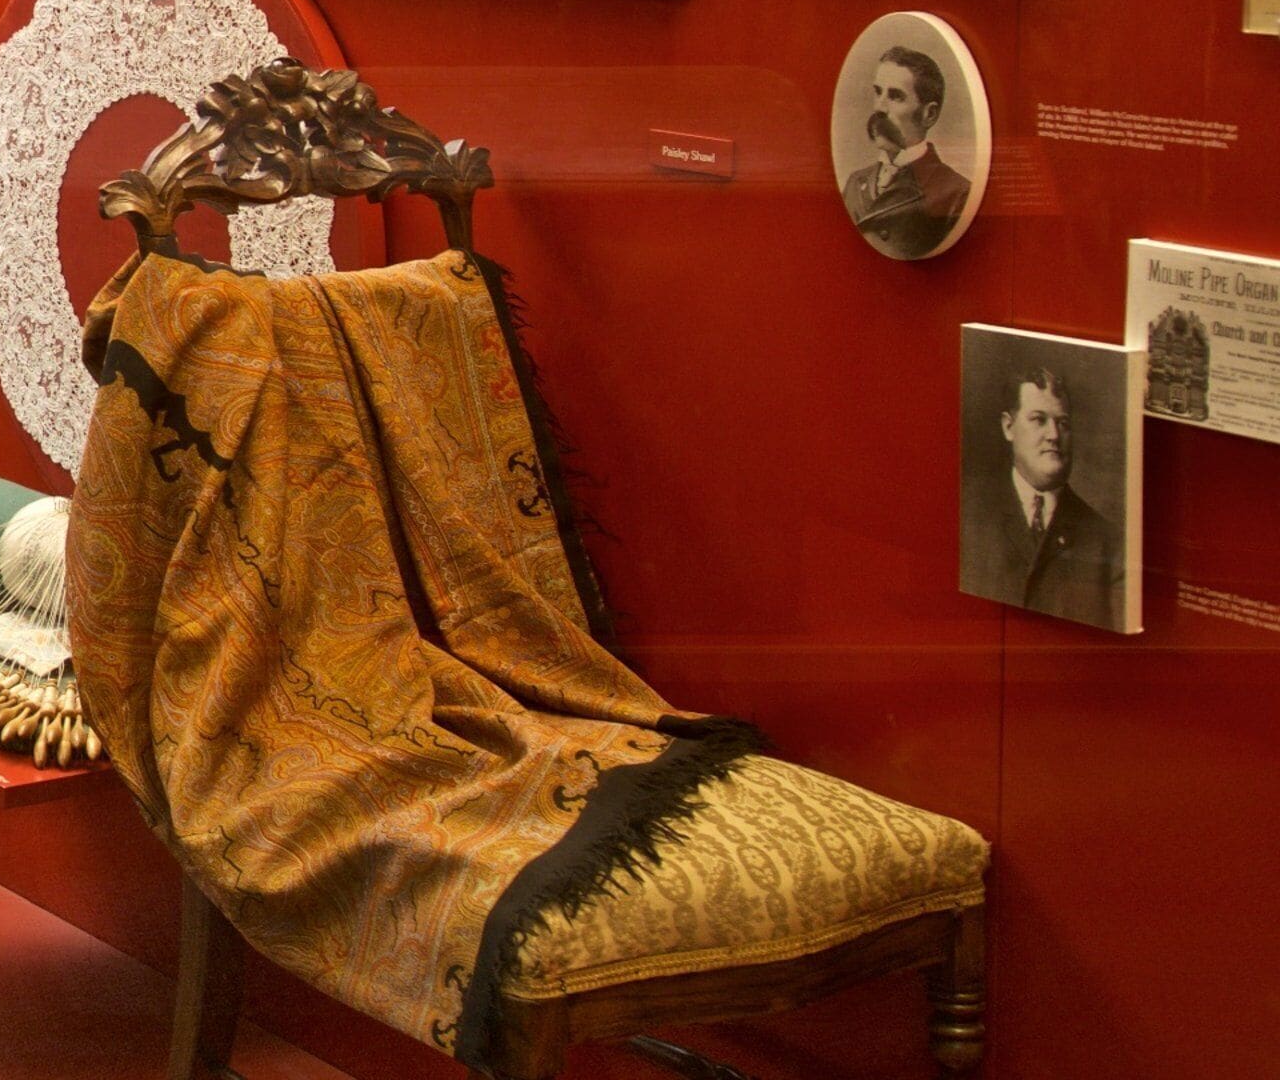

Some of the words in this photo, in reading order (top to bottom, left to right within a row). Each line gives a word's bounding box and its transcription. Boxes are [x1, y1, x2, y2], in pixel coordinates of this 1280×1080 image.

[1148, 259, 1194, 288] MOLINE
[1200, 266, 1229, 294] PIPE
[1235, 272, 1279, 301] ORGAN
